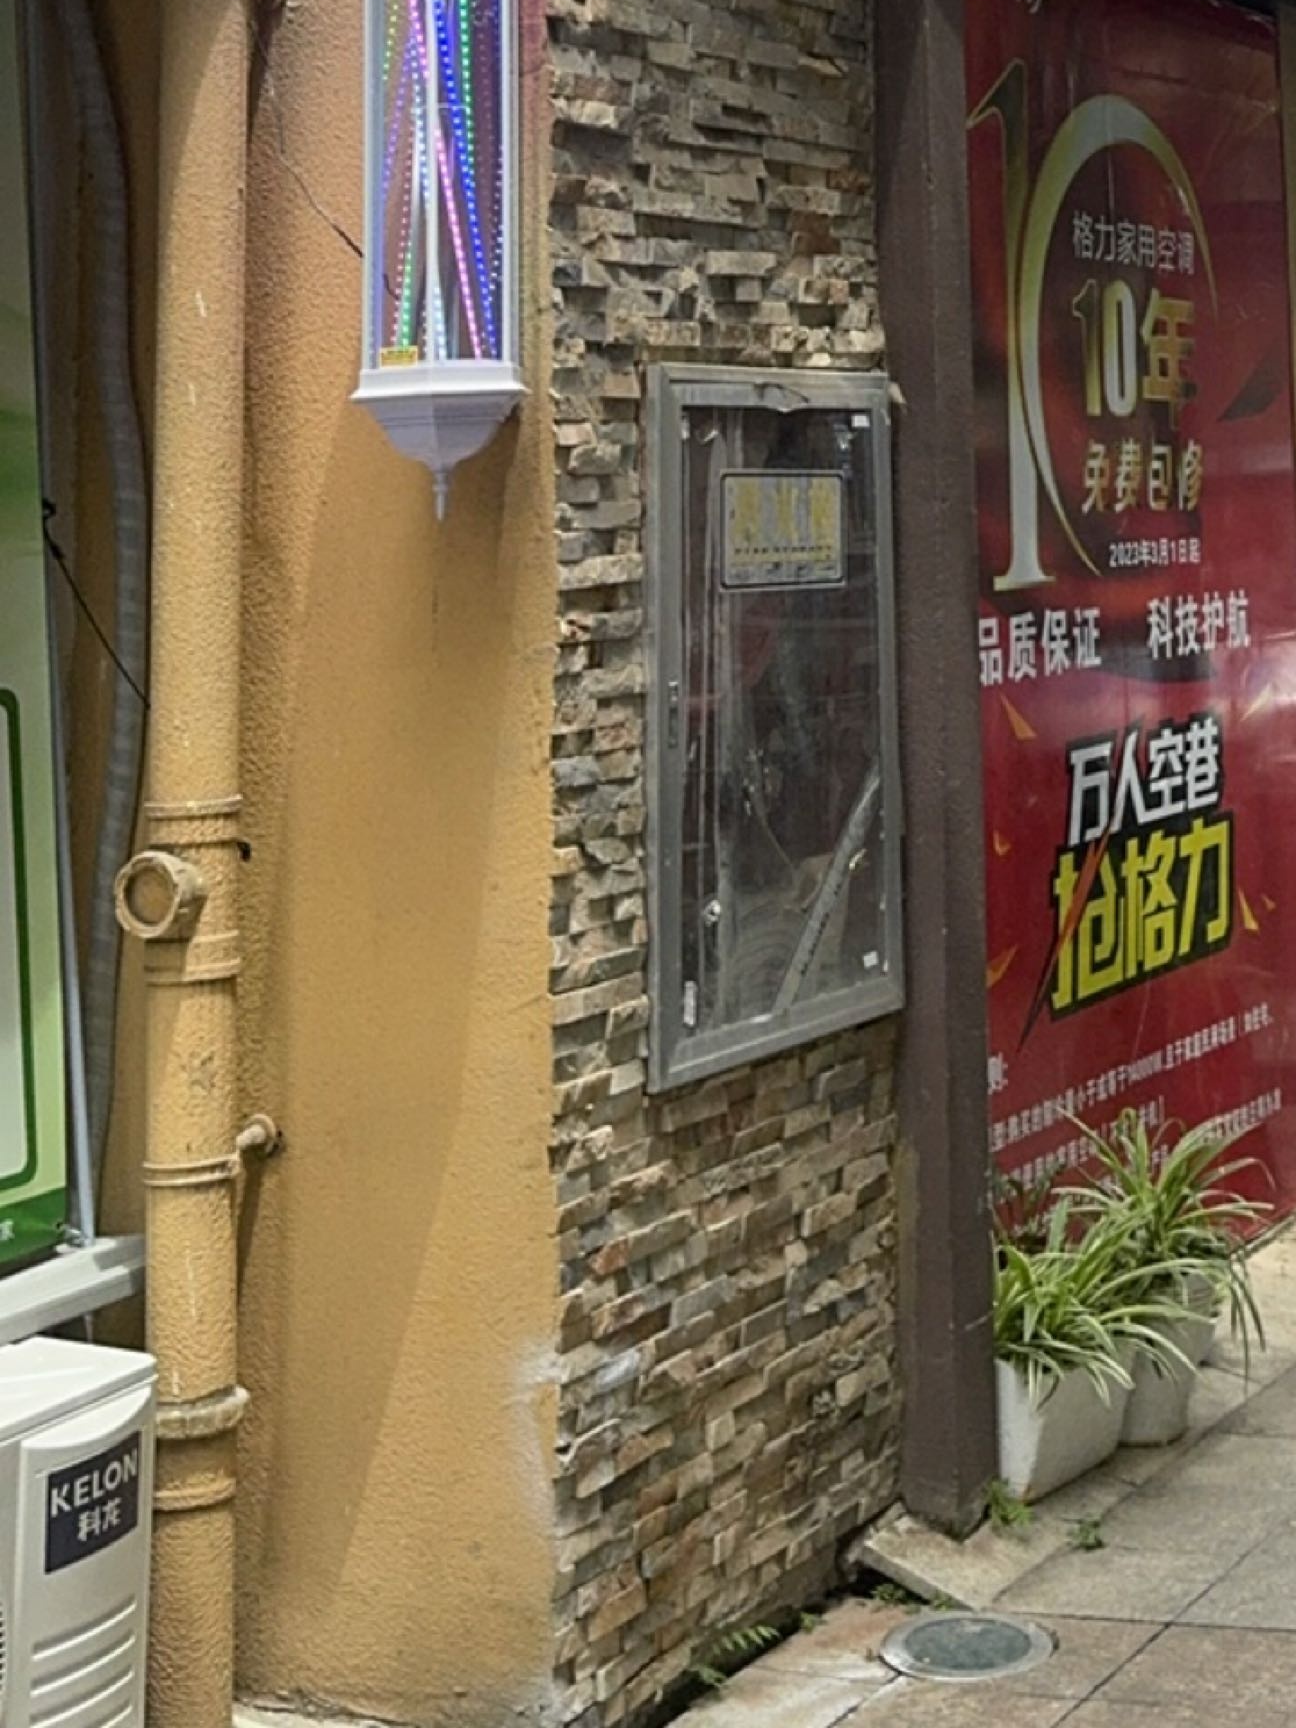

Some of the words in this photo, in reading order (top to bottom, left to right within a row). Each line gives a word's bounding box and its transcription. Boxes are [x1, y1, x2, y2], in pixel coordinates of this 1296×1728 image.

[1072, 210, 1195, 275] 格力家用空调
[1072, 278, 1196, 429] 10年
[1082, 440, 1203, 515] 免费包修
[979, 607, 1102, 686] 品质保证
[1146, 588, 1250, 661] 科技护航
[1066, 718, 1220, 848] 万人空巷
[1051, 816, 1232, 1012] 抢格力
[50, 1448, 139, 1519] KELON
